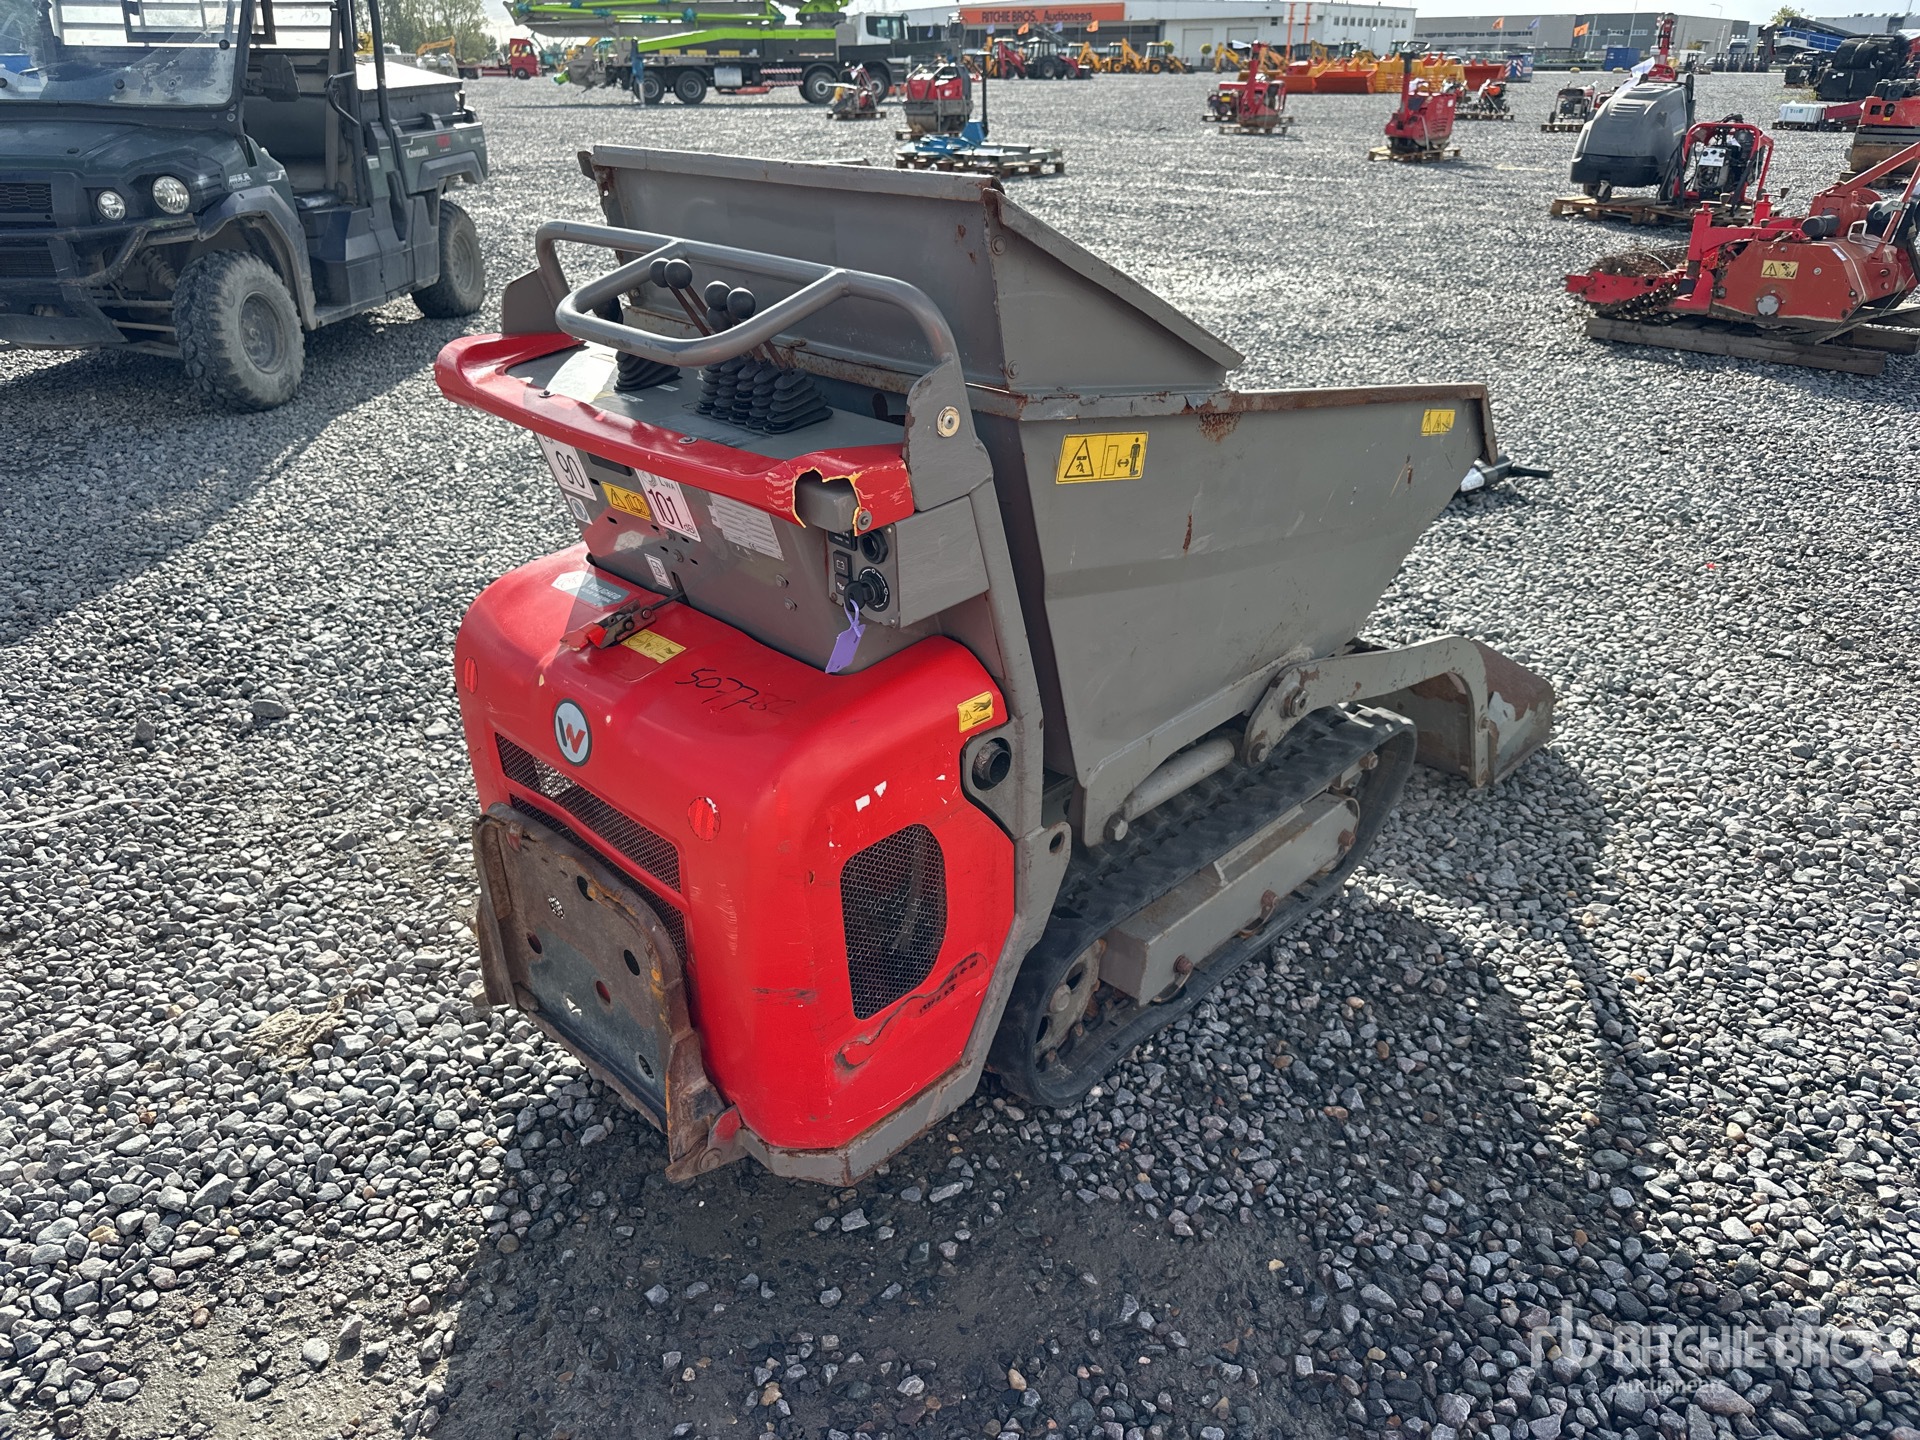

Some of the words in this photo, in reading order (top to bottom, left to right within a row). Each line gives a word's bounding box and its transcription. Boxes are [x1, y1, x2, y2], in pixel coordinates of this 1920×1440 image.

[981, 11, 1010, 23] RITCHIE
[1043, 10, 1092, 22] Auctioneers
[555, 450, 585, 489] 90
[647, 488, 684, 529] 101
